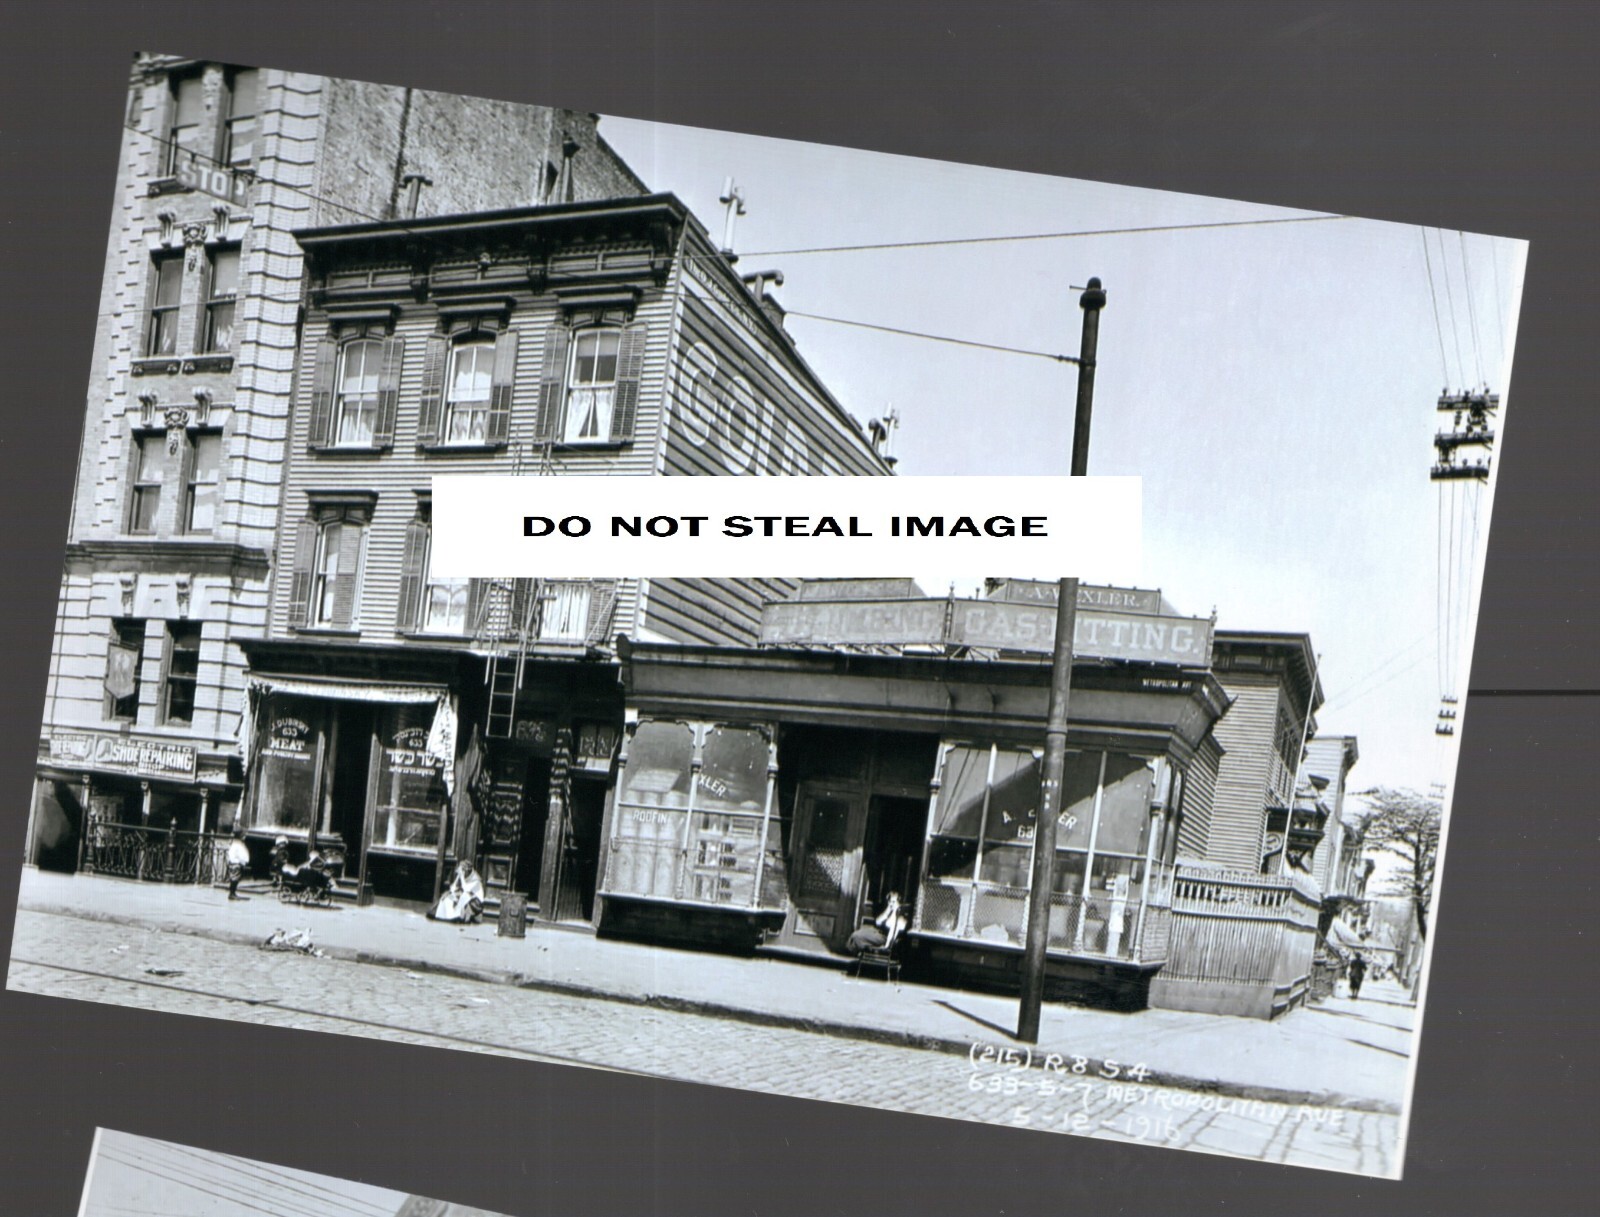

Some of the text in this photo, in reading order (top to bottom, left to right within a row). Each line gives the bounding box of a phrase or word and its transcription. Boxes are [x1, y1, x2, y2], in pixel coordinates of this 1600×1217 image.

[282, 726, 298, 738] 633
[117, 739, 192, 753] ELECTRIC
[270, 736, 306, 751] MEAT
[112, 745, 194, 771] SHOE REPAIRING
[386, 748, 415, 765] כשר
